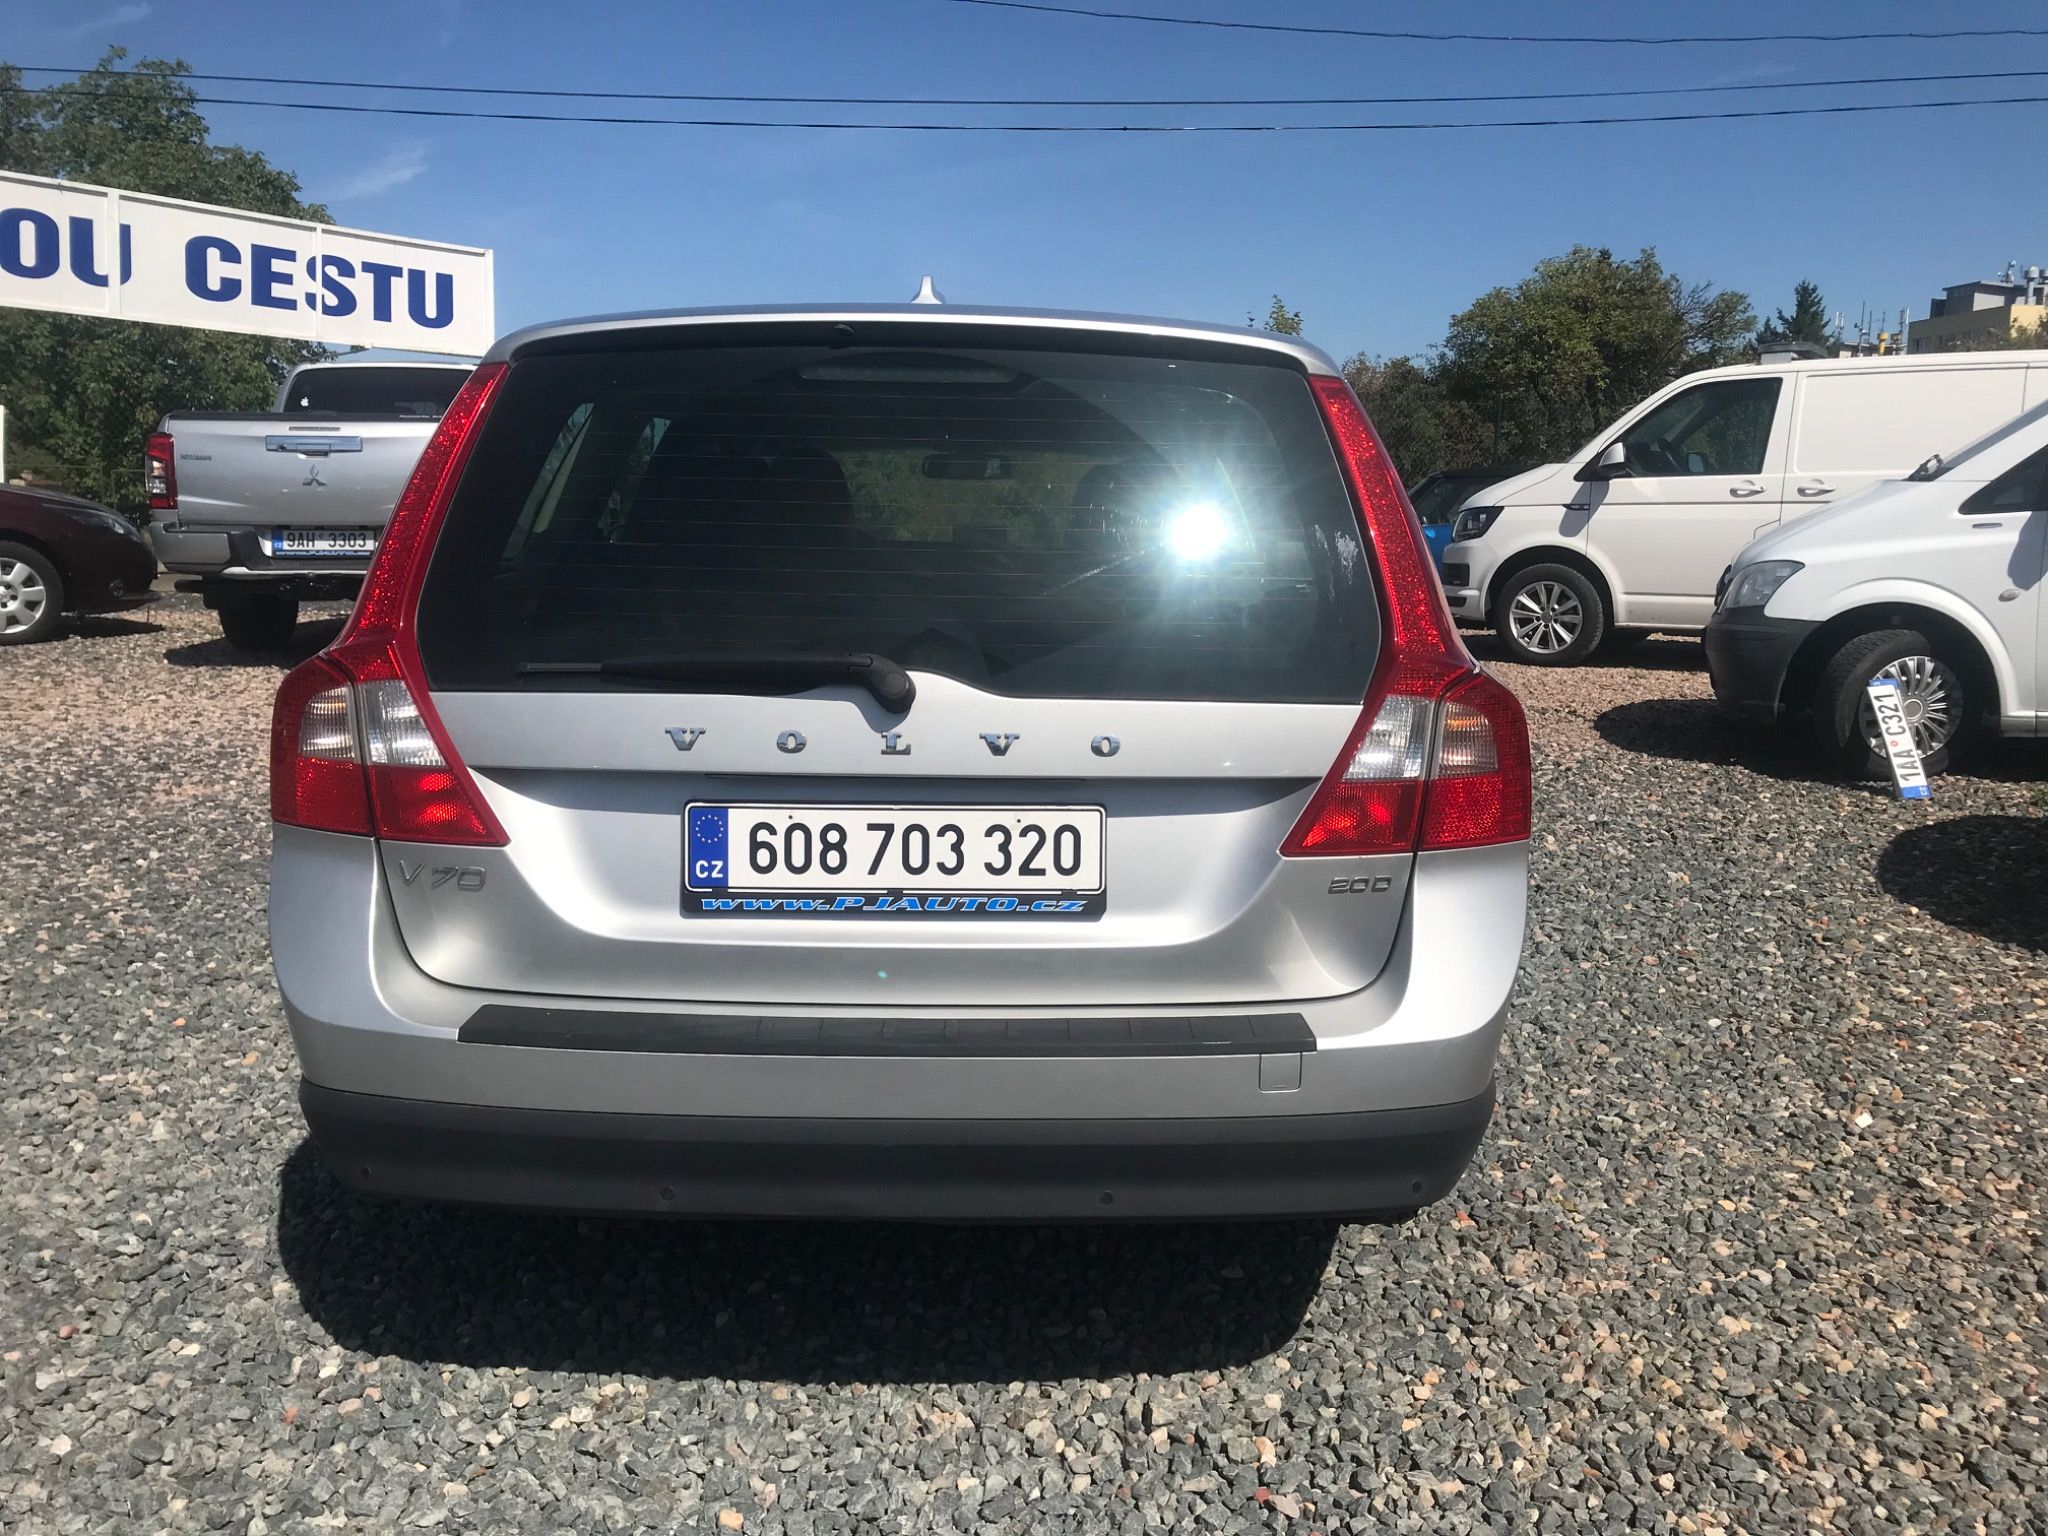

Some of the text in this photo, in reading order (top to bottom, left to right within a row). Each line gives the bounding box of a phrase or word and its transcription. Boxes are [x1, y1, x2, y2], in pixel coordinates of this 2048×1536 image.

[185, 235, 454, 330] CESTU
[287, 532, 367, 549] 9AH 3303
[1874, 694, 1921, 782] 1AA C321
[695, 860, 724, 879] CZ
[749, 821, 1082, 877] 608 703 320
